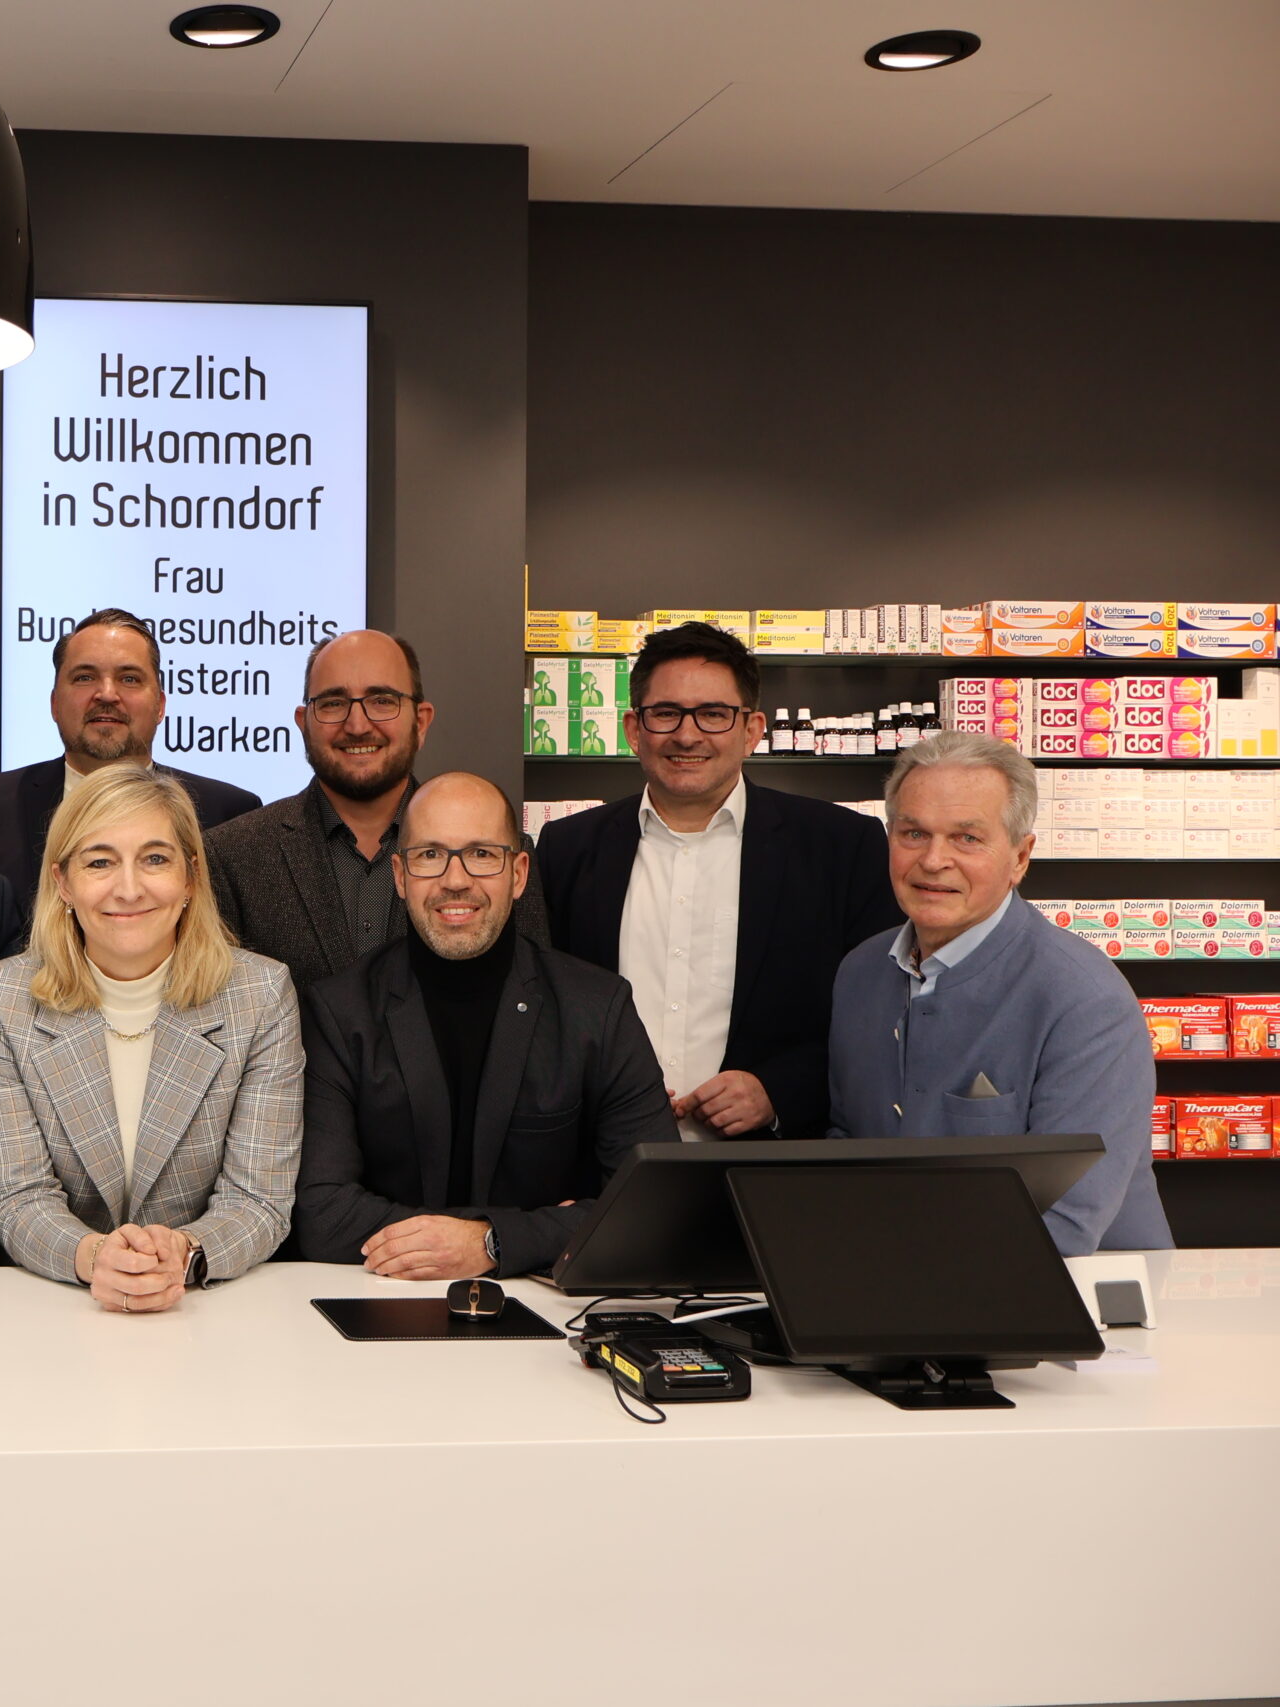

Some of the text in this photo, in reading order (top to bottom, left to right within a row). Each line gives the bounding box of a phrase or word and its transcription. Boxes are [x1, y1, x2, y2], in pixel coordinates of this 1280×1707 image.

[100, 353, 266, 400] Herzlich
[53, 417, 311, 466] Willkommen
[43, 481, 324, 530] in Schorndorf
[154, 558, 224, 594] Frau
[1009, 605, 1042, 616] Voltaren
[1103, 606, 1135, 615] Voltaren
[1198, 608, 1230, 616] Voltaren
[1009, 632, 1042, 643] Voltaren
[1102, 634, 1135, 643] Voltaren
[1198, 635, 1230, 643] Voltaren
[959, 681, 984, 694] doc
[1043, 683, 1076, 699] doc
[1128, 681, 1164, 699] doc
[959, 701, 984, 713] doc
[1043, 709, 1076, 725] doc
[1126, 707, 1163, 726] doc
[959, 720, 984, 733] doc
[164, 716, 290, 752] Warken
[1042, 735, 1075, 751] doc
[1126, 734, 1162, 752] doc
[1124, 902, 1163, 910] Dolormin
[1126, 931, 1165, 939] Dolormin
[1142, 1004, 1220, 1013] ThermaCare
[1185, 1104, 1264, 1112] ThermaCare
